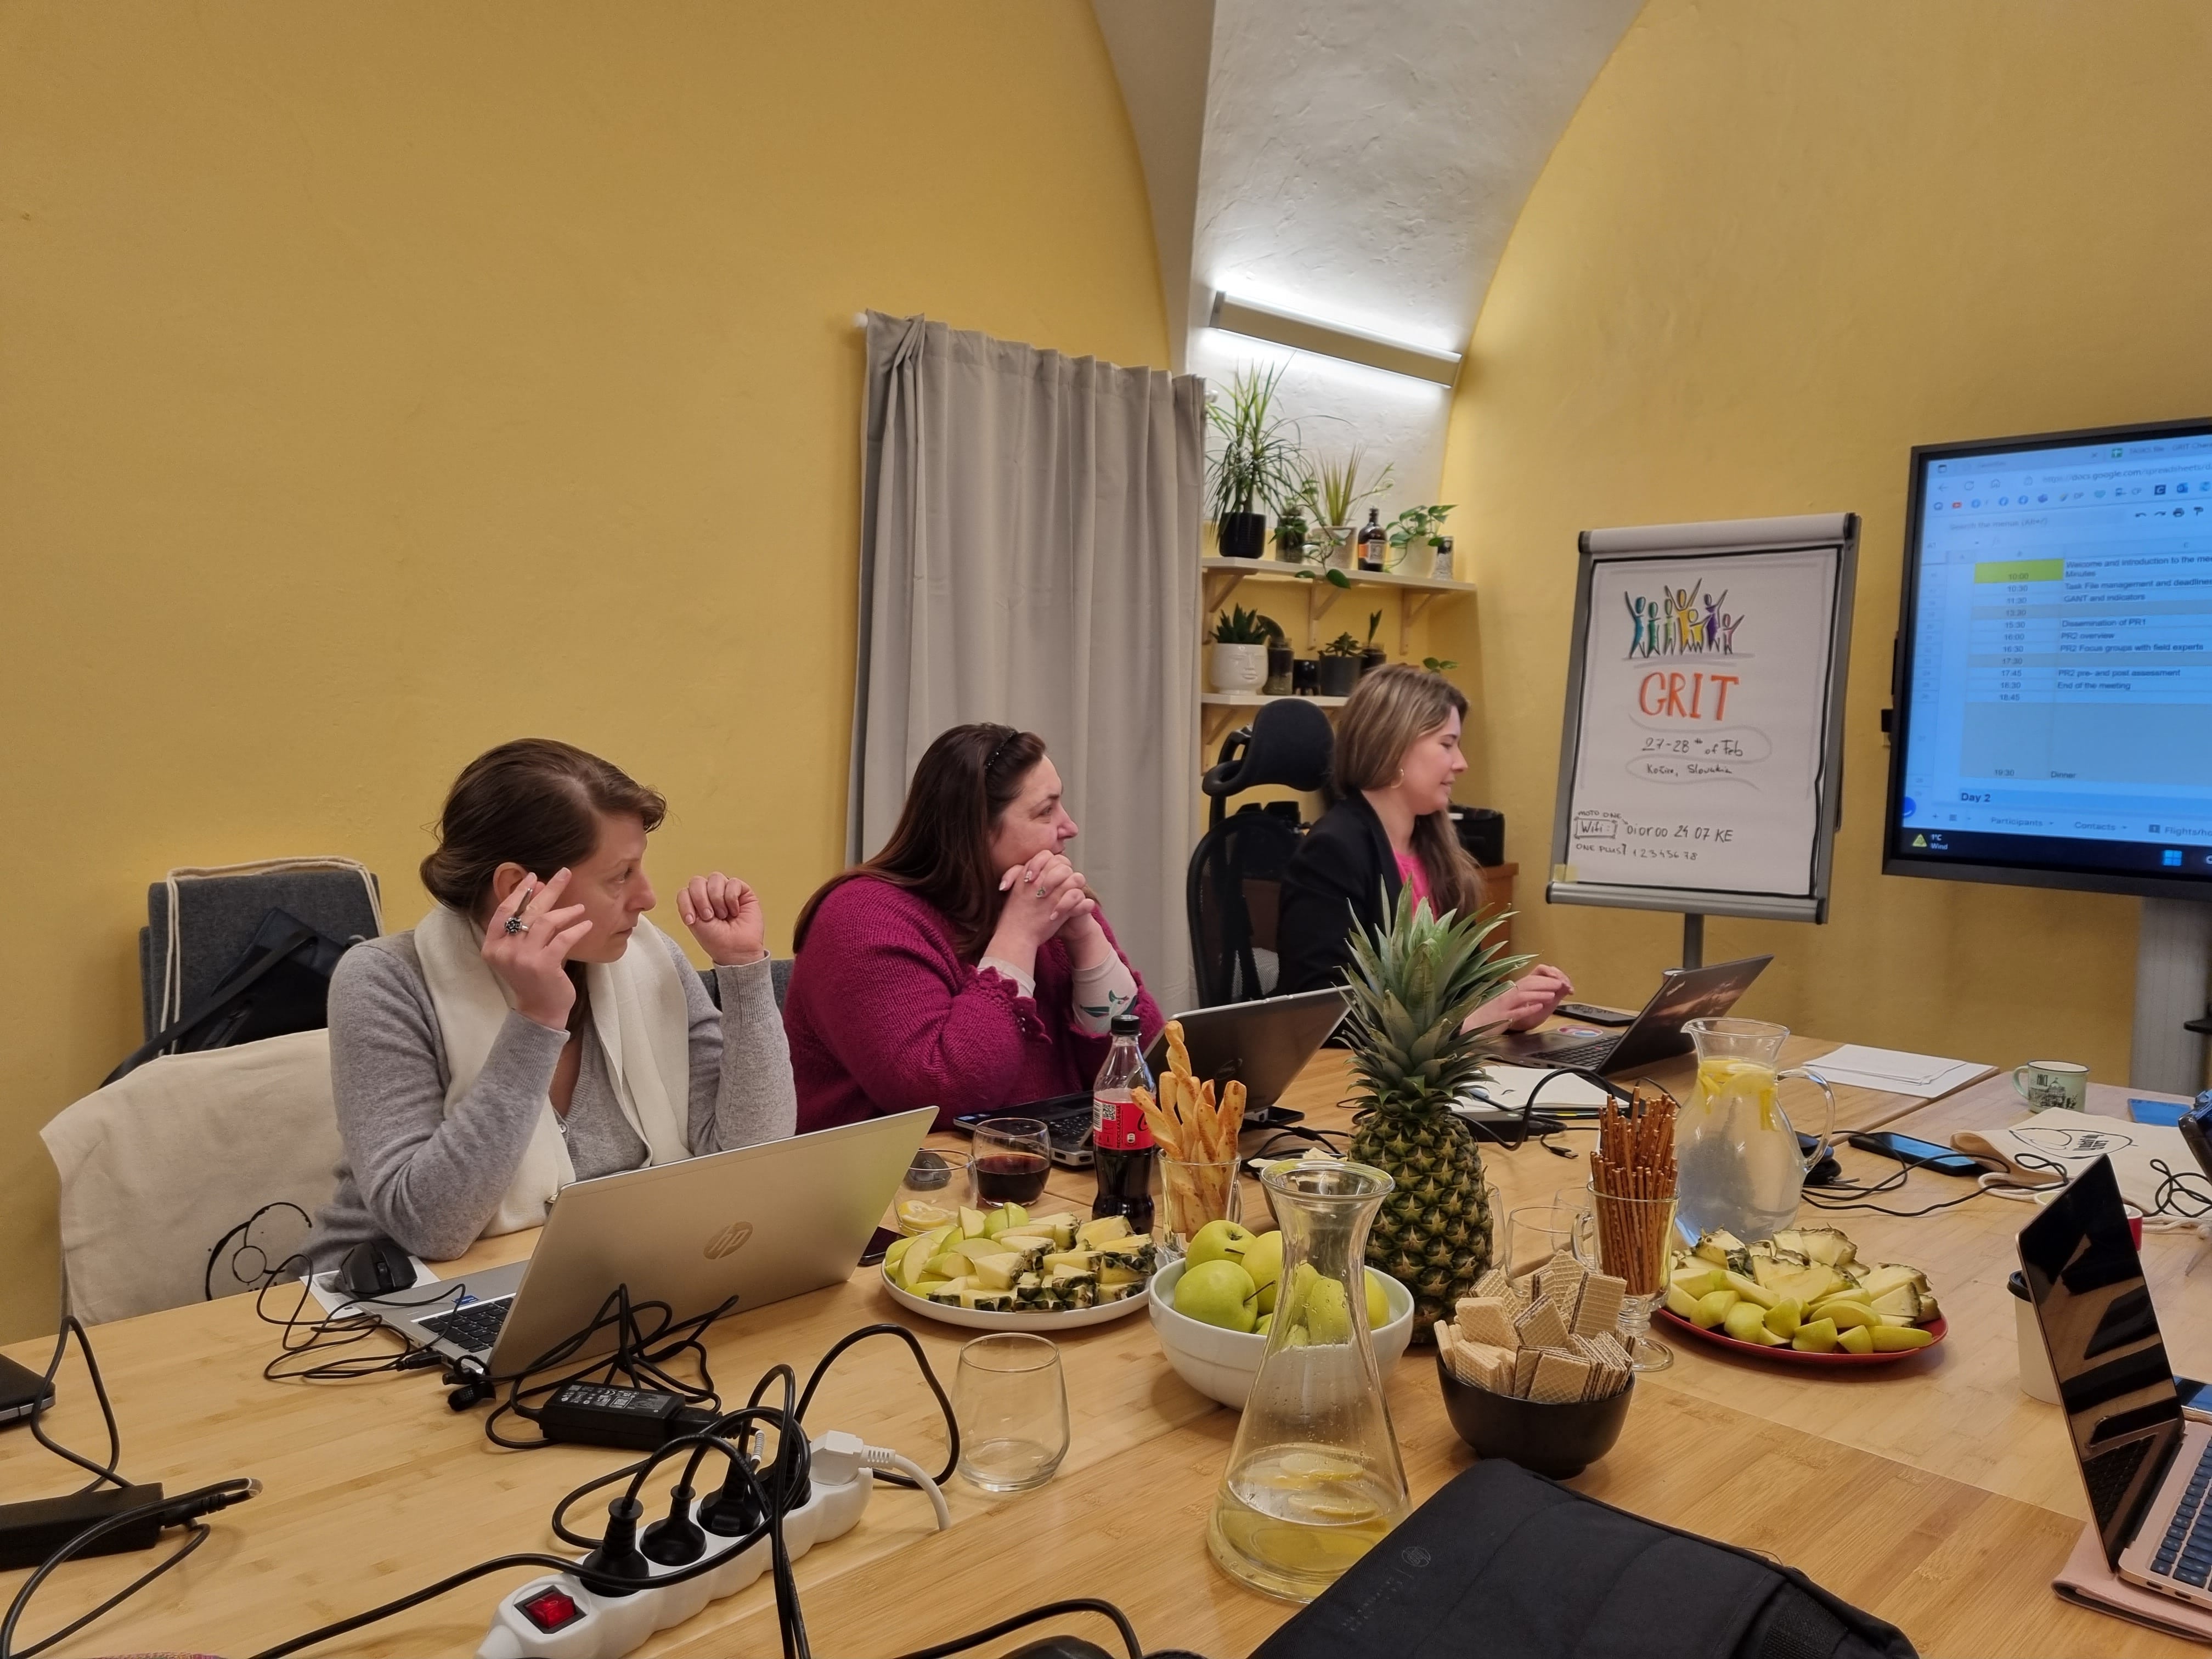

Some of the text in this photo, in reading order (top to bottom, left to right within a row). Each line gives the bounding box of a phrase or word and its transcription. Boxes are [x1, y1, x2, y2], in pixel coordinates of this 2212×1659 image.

[2066, 560, 2103, 568] Welcome
[2121, 557, 2169, 566] introduction
[2065, 570, 2096, 578] Minutes
[2065, 582, 2083, 590] Task
[2101, 580, 2153, 590] management
[2107, 593, 2146, 601] indicators
[2062, 618, 2117, 627] Dissemination
[2129, 618, 2146, 626] PR1
[2080, 631, 2115, 640] overview
[2105, 645, 2132, 653] groups
[2172, 643, 2204, 652] experts
[2112, 669, 2129, 678] post
[2099, 682, 2131, 691] meeting
[1638, 671, 1740, 721] GRIT
[1705, 743, 1719, 755] of
[1720, 740, 1743, 757] Feb
[2051, 771, 2076, 779] Dinner
[1961, 792, 1991, 803] Day 2
[1991, 816, 2043, 827] Participants
[2074, 821, 2116, 831] Contacts
[1715, 829, 1734, 843] KE
